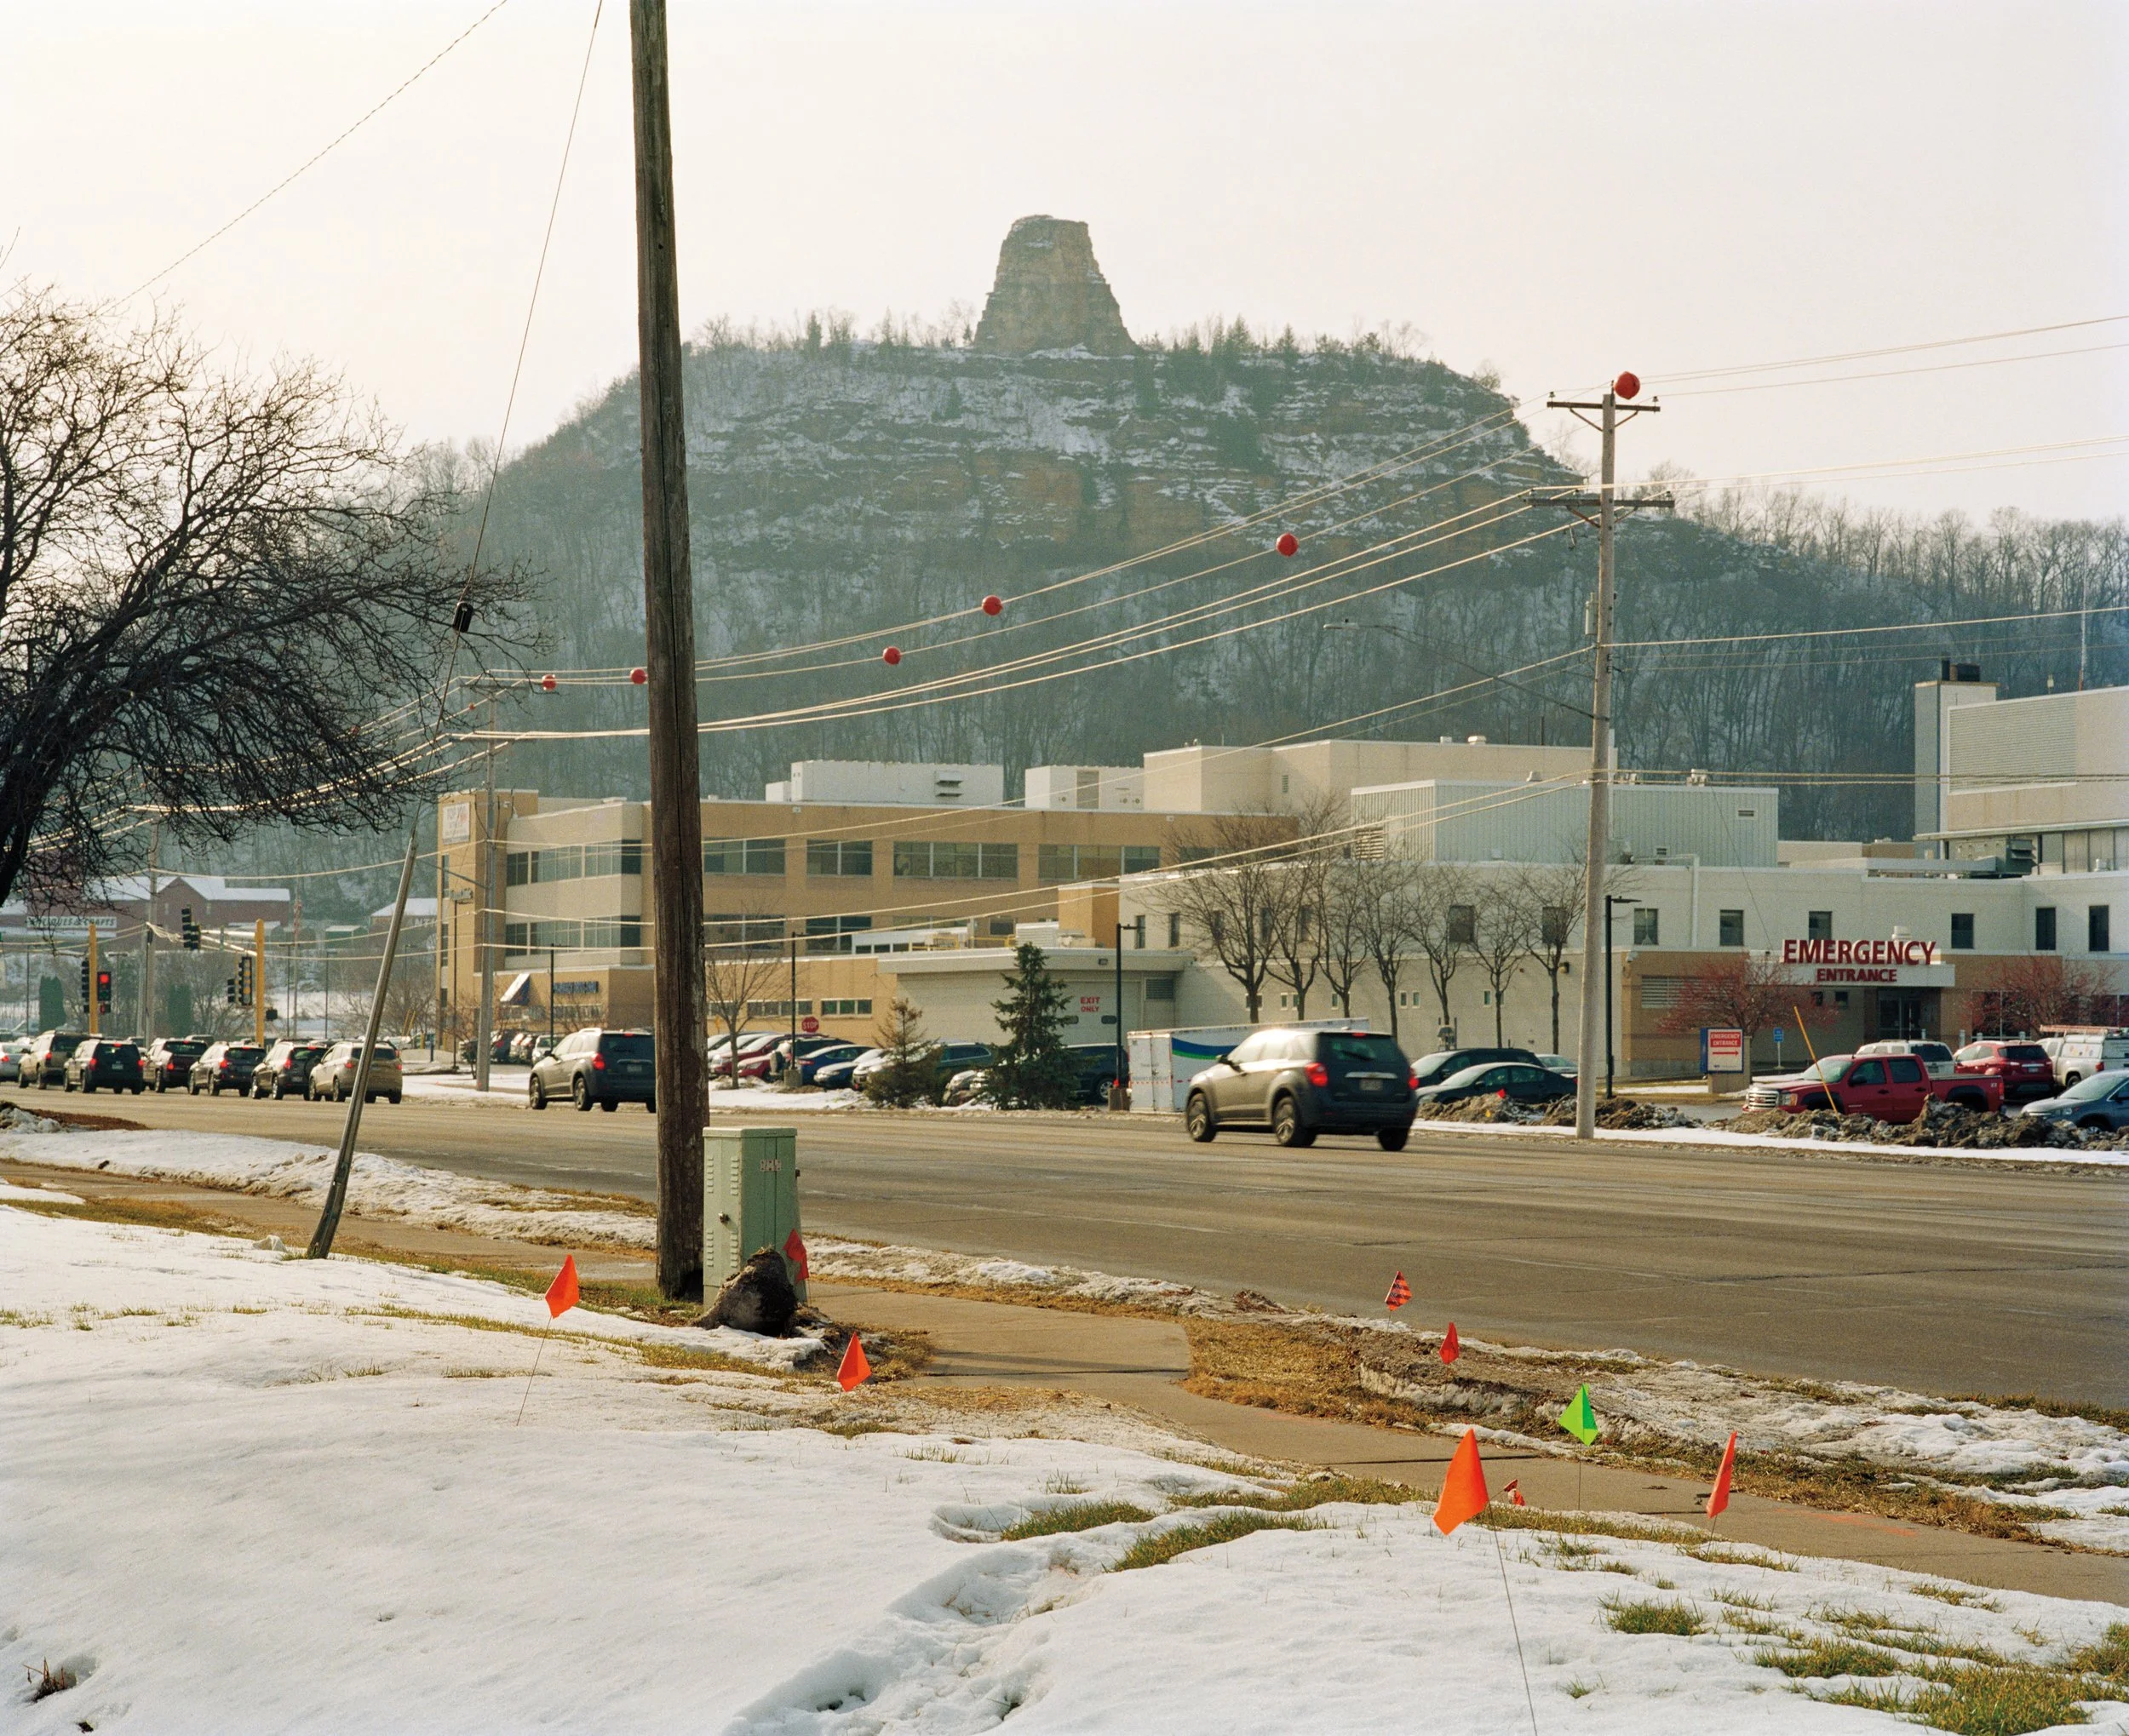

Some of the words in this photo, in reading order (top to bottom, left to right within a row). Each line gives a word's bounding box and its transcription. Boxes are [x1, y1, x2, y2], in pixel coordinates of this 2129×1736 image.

[1783, 939, 1936, 965] EMERGENCY
[1816, 968, 1897, 983] ENTRANCE
[802, 1021, 818, 1029] STOP
